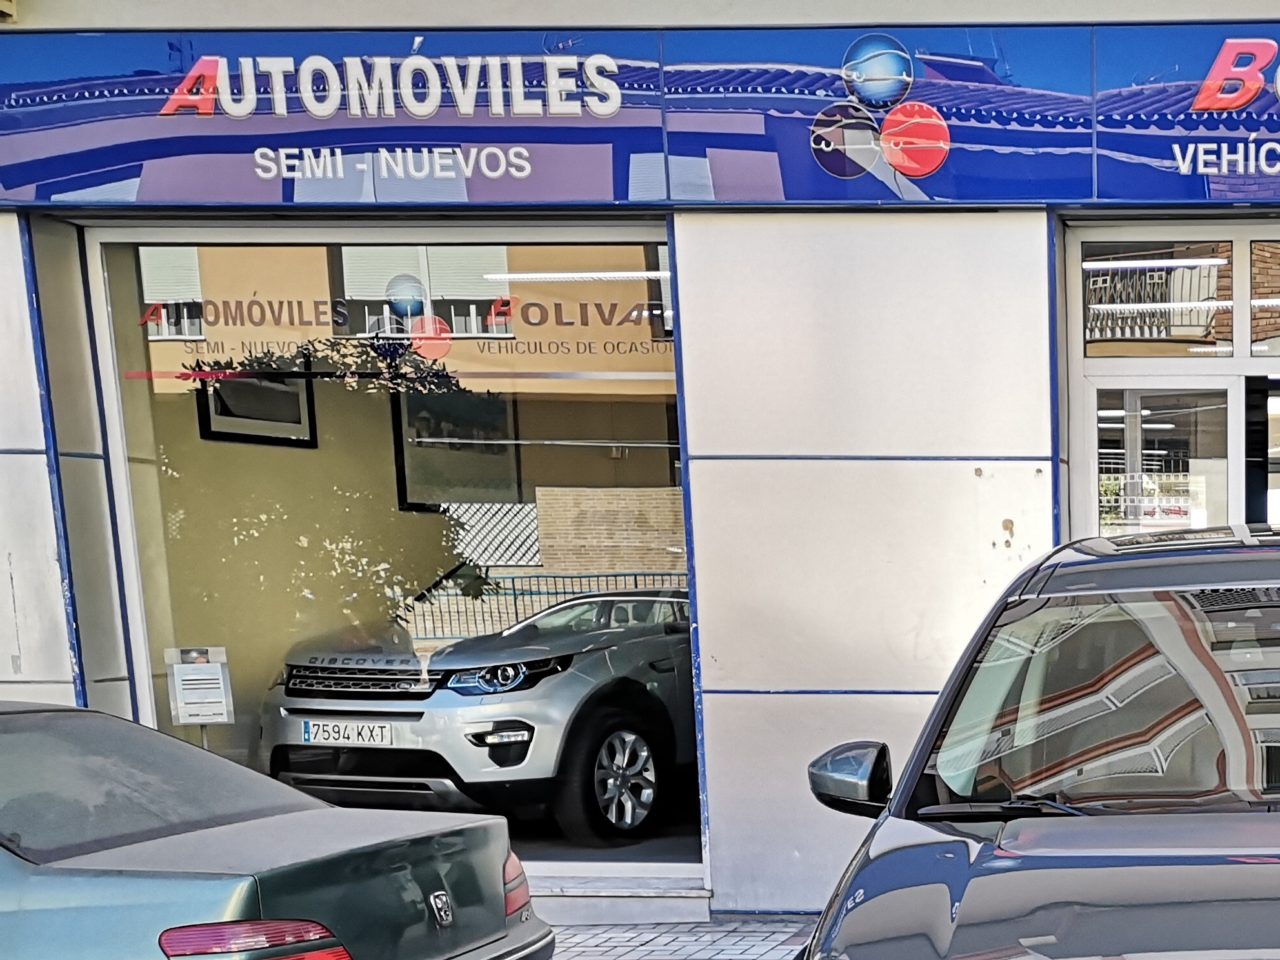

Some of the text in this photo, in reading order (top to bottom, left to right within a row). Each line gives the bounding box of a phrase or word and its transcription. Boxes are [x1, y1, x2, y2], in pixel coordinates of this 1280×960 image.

[160, 37, 621, 118] AUTOMÓVILES
[254, 146, 344, 180] SEMI
[378, 147, 532, 179] NUEVOS
[184, 341, 225, 355] SEMI
[577, 341, 598, 355] DE
[312, 723, 387, 743] 7594 KXT
